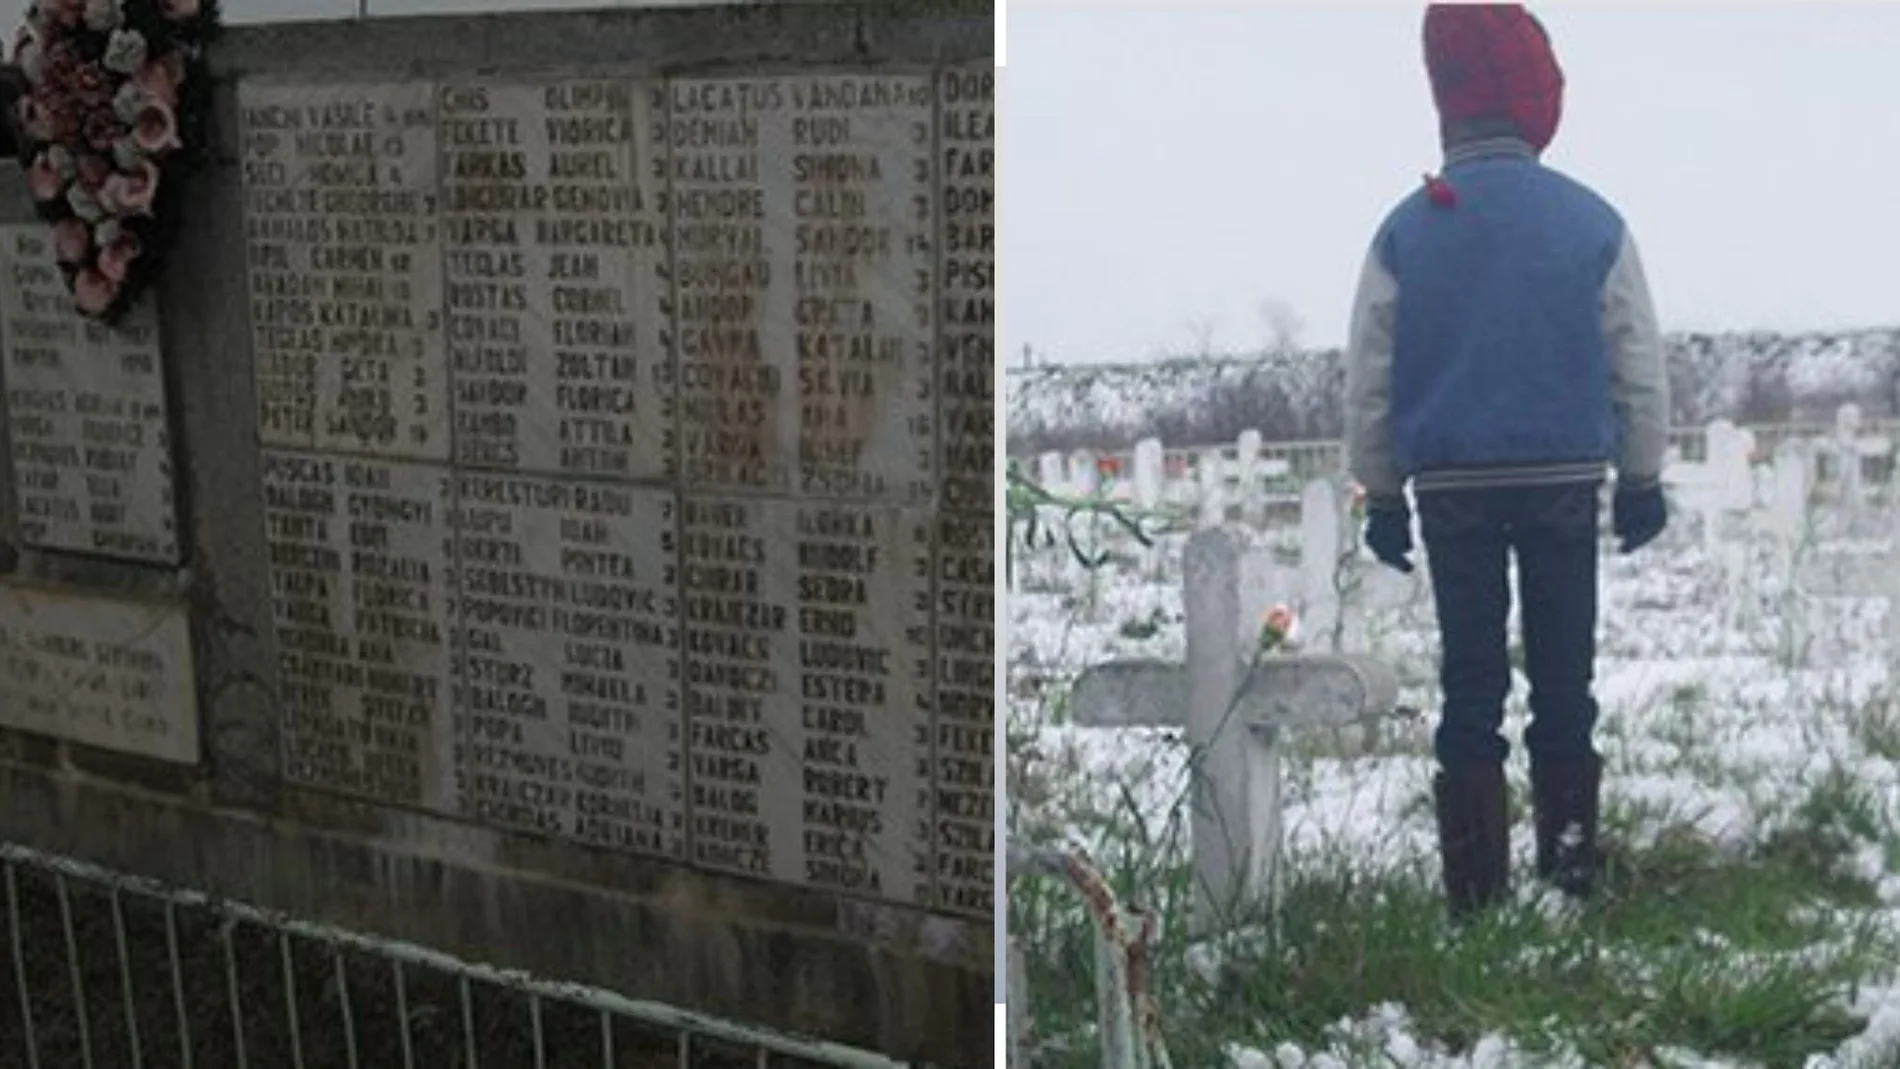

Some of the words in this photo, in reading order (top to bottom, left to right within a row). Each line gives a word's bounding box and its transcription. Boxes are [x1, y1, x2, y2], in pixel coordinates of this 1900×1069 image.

[673, 82, 781, 109] LACATUS
[441, 118, 518, 144] FEKETE
[545, 117, 633, 144] VIORICA
[673, 116, 758, 146] DEMIAN
[441, 151, 526, 178] FARKAS
[548, 150, 616, 178] AUREL
[447, 218, 517, 245] VARGA
[555, 351, 637, 379] ZOLTAN
